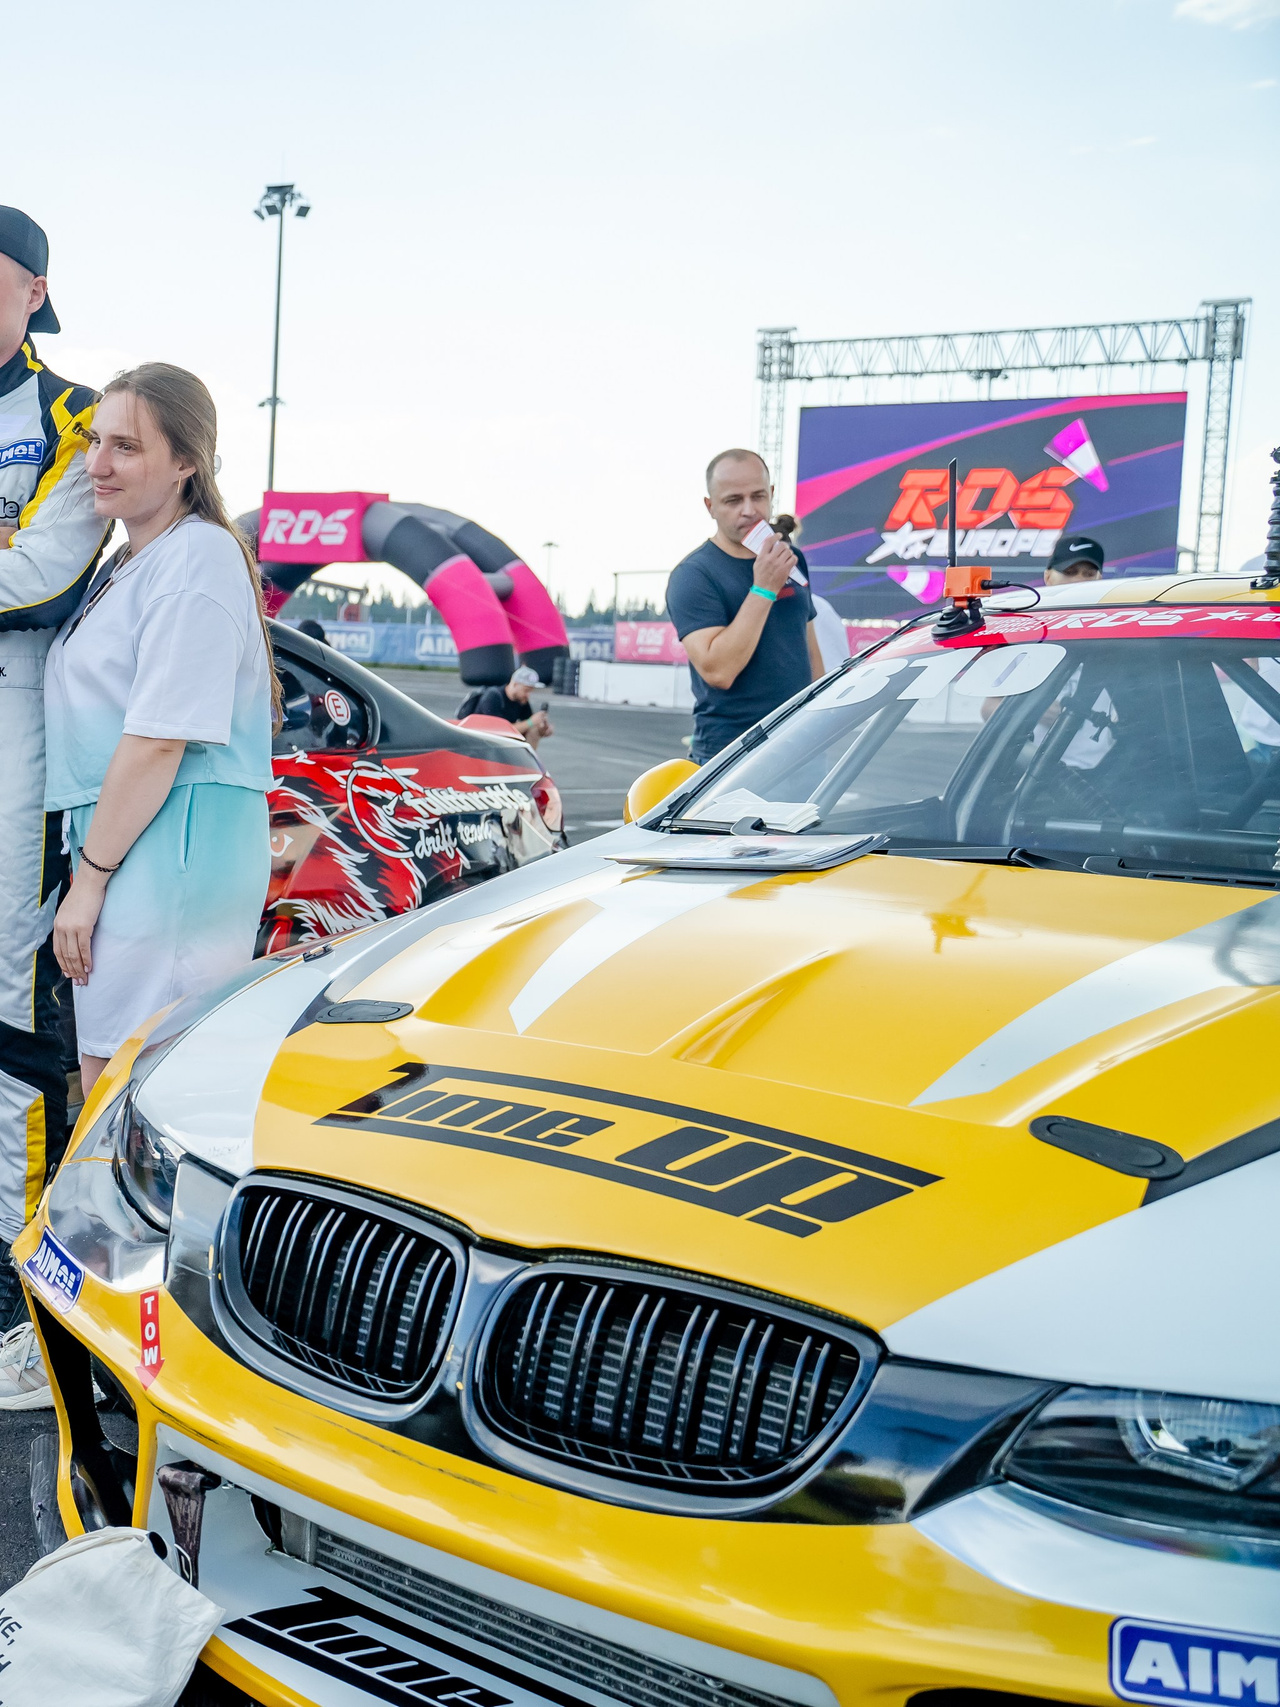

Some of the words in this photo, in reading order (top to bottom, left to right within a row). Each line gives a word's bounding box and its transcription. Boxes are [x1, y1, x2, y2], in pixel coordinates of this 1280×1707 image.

[884, 467, 1080, 530] RDS
[261, 508, 356, 546] RDS
[926, 528, 1063, 557] EUROPE
[1049, 608, 1203, 630] RDS
[571, 641, 614, 660] MOL
[804, 643, 1067, 712] 810
[331, 698, 344, 717] E
[402, 782, 532, 818] fullthrottle
[414, 818, 458, 859] drift
[31, 1240, 76, 1299] AIMOL
[143, 1295, 159, 1367] TOW
